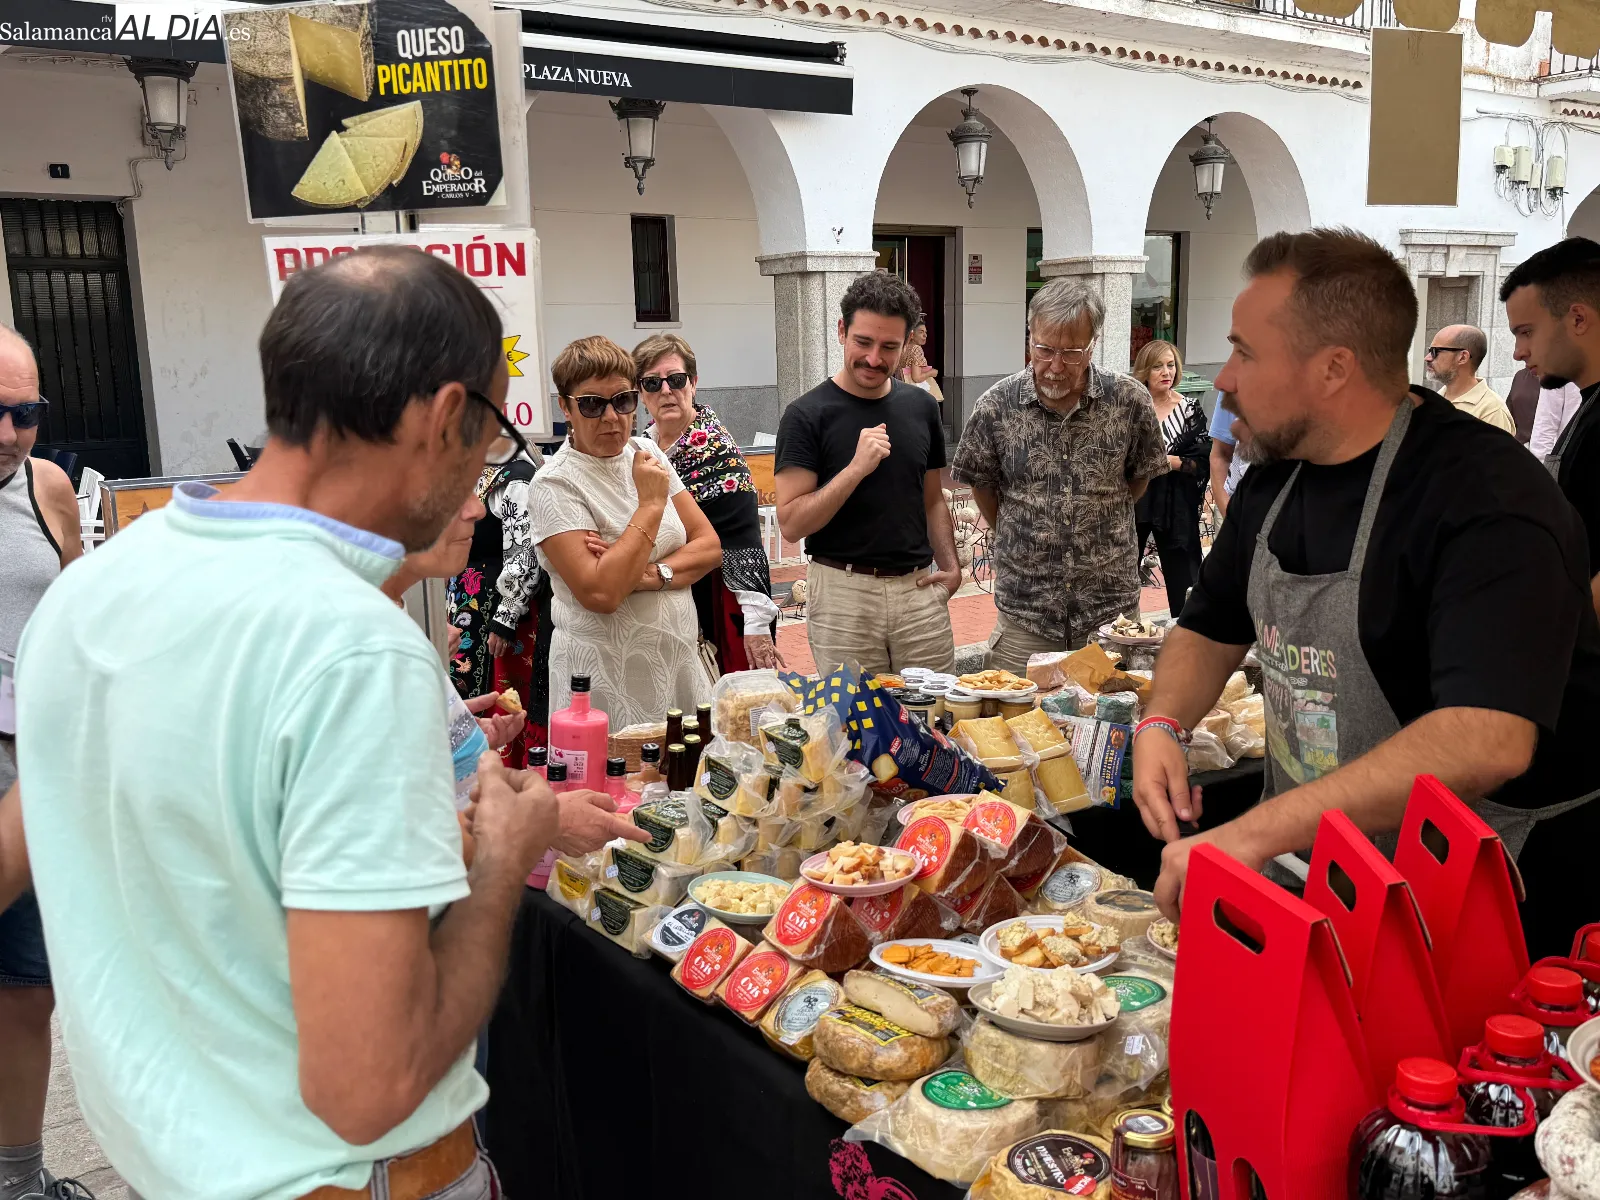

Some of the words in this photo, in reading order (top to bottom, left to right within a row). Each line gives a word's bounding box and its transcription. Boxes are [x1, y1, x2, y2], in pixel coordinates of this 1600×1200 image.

[396, 25, 466, 60] QUESO
[376, 57, 489, 96] PICANTITO
[521, 63, 575, 83] PLAZA
[576, 68, 633, 88] NUEVA
[421, 177, 488, 196] EMPERADOR
